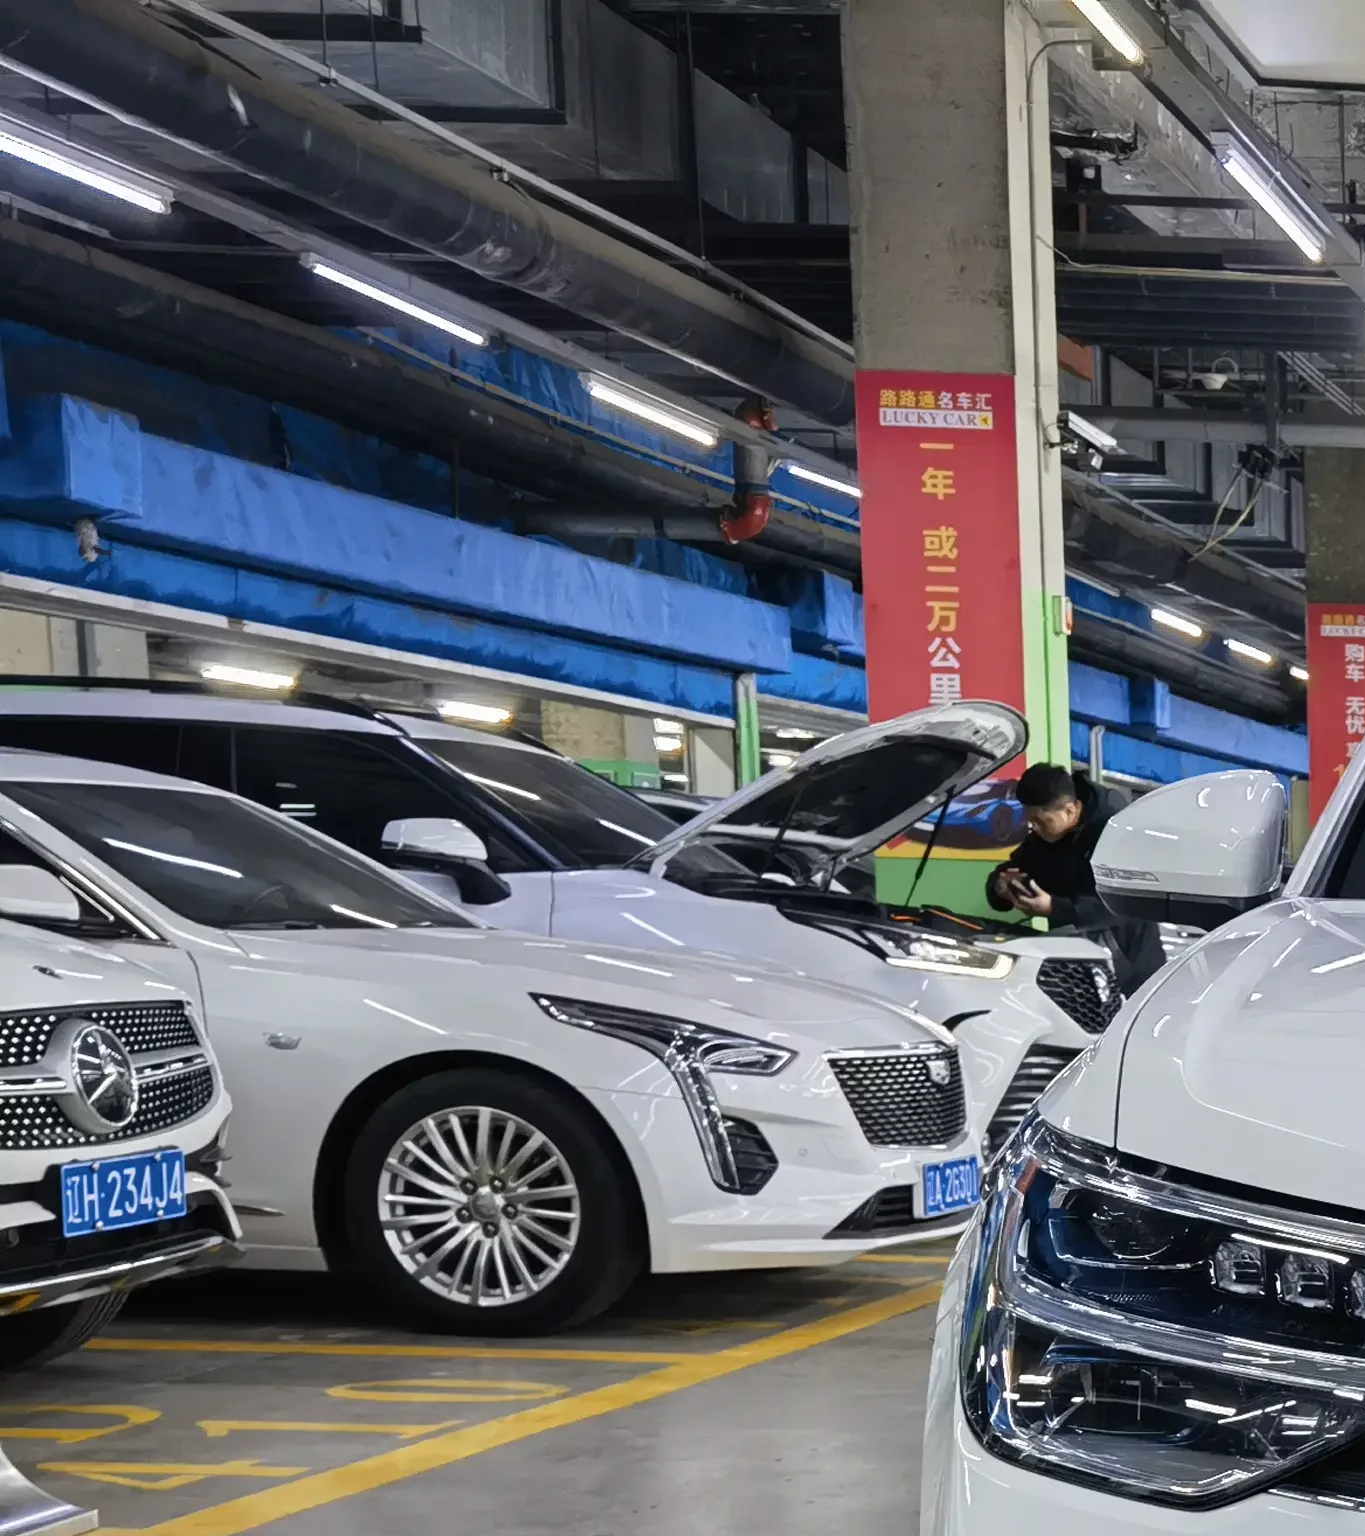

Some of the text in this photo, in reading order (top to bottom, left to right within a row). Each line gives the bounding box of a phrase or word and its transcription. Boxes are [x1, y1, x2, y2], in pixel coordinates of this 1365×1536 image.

[879, 388, 993, 410] 路路通名车汇
[882, 410, 978, 426] LUCKY CAR
